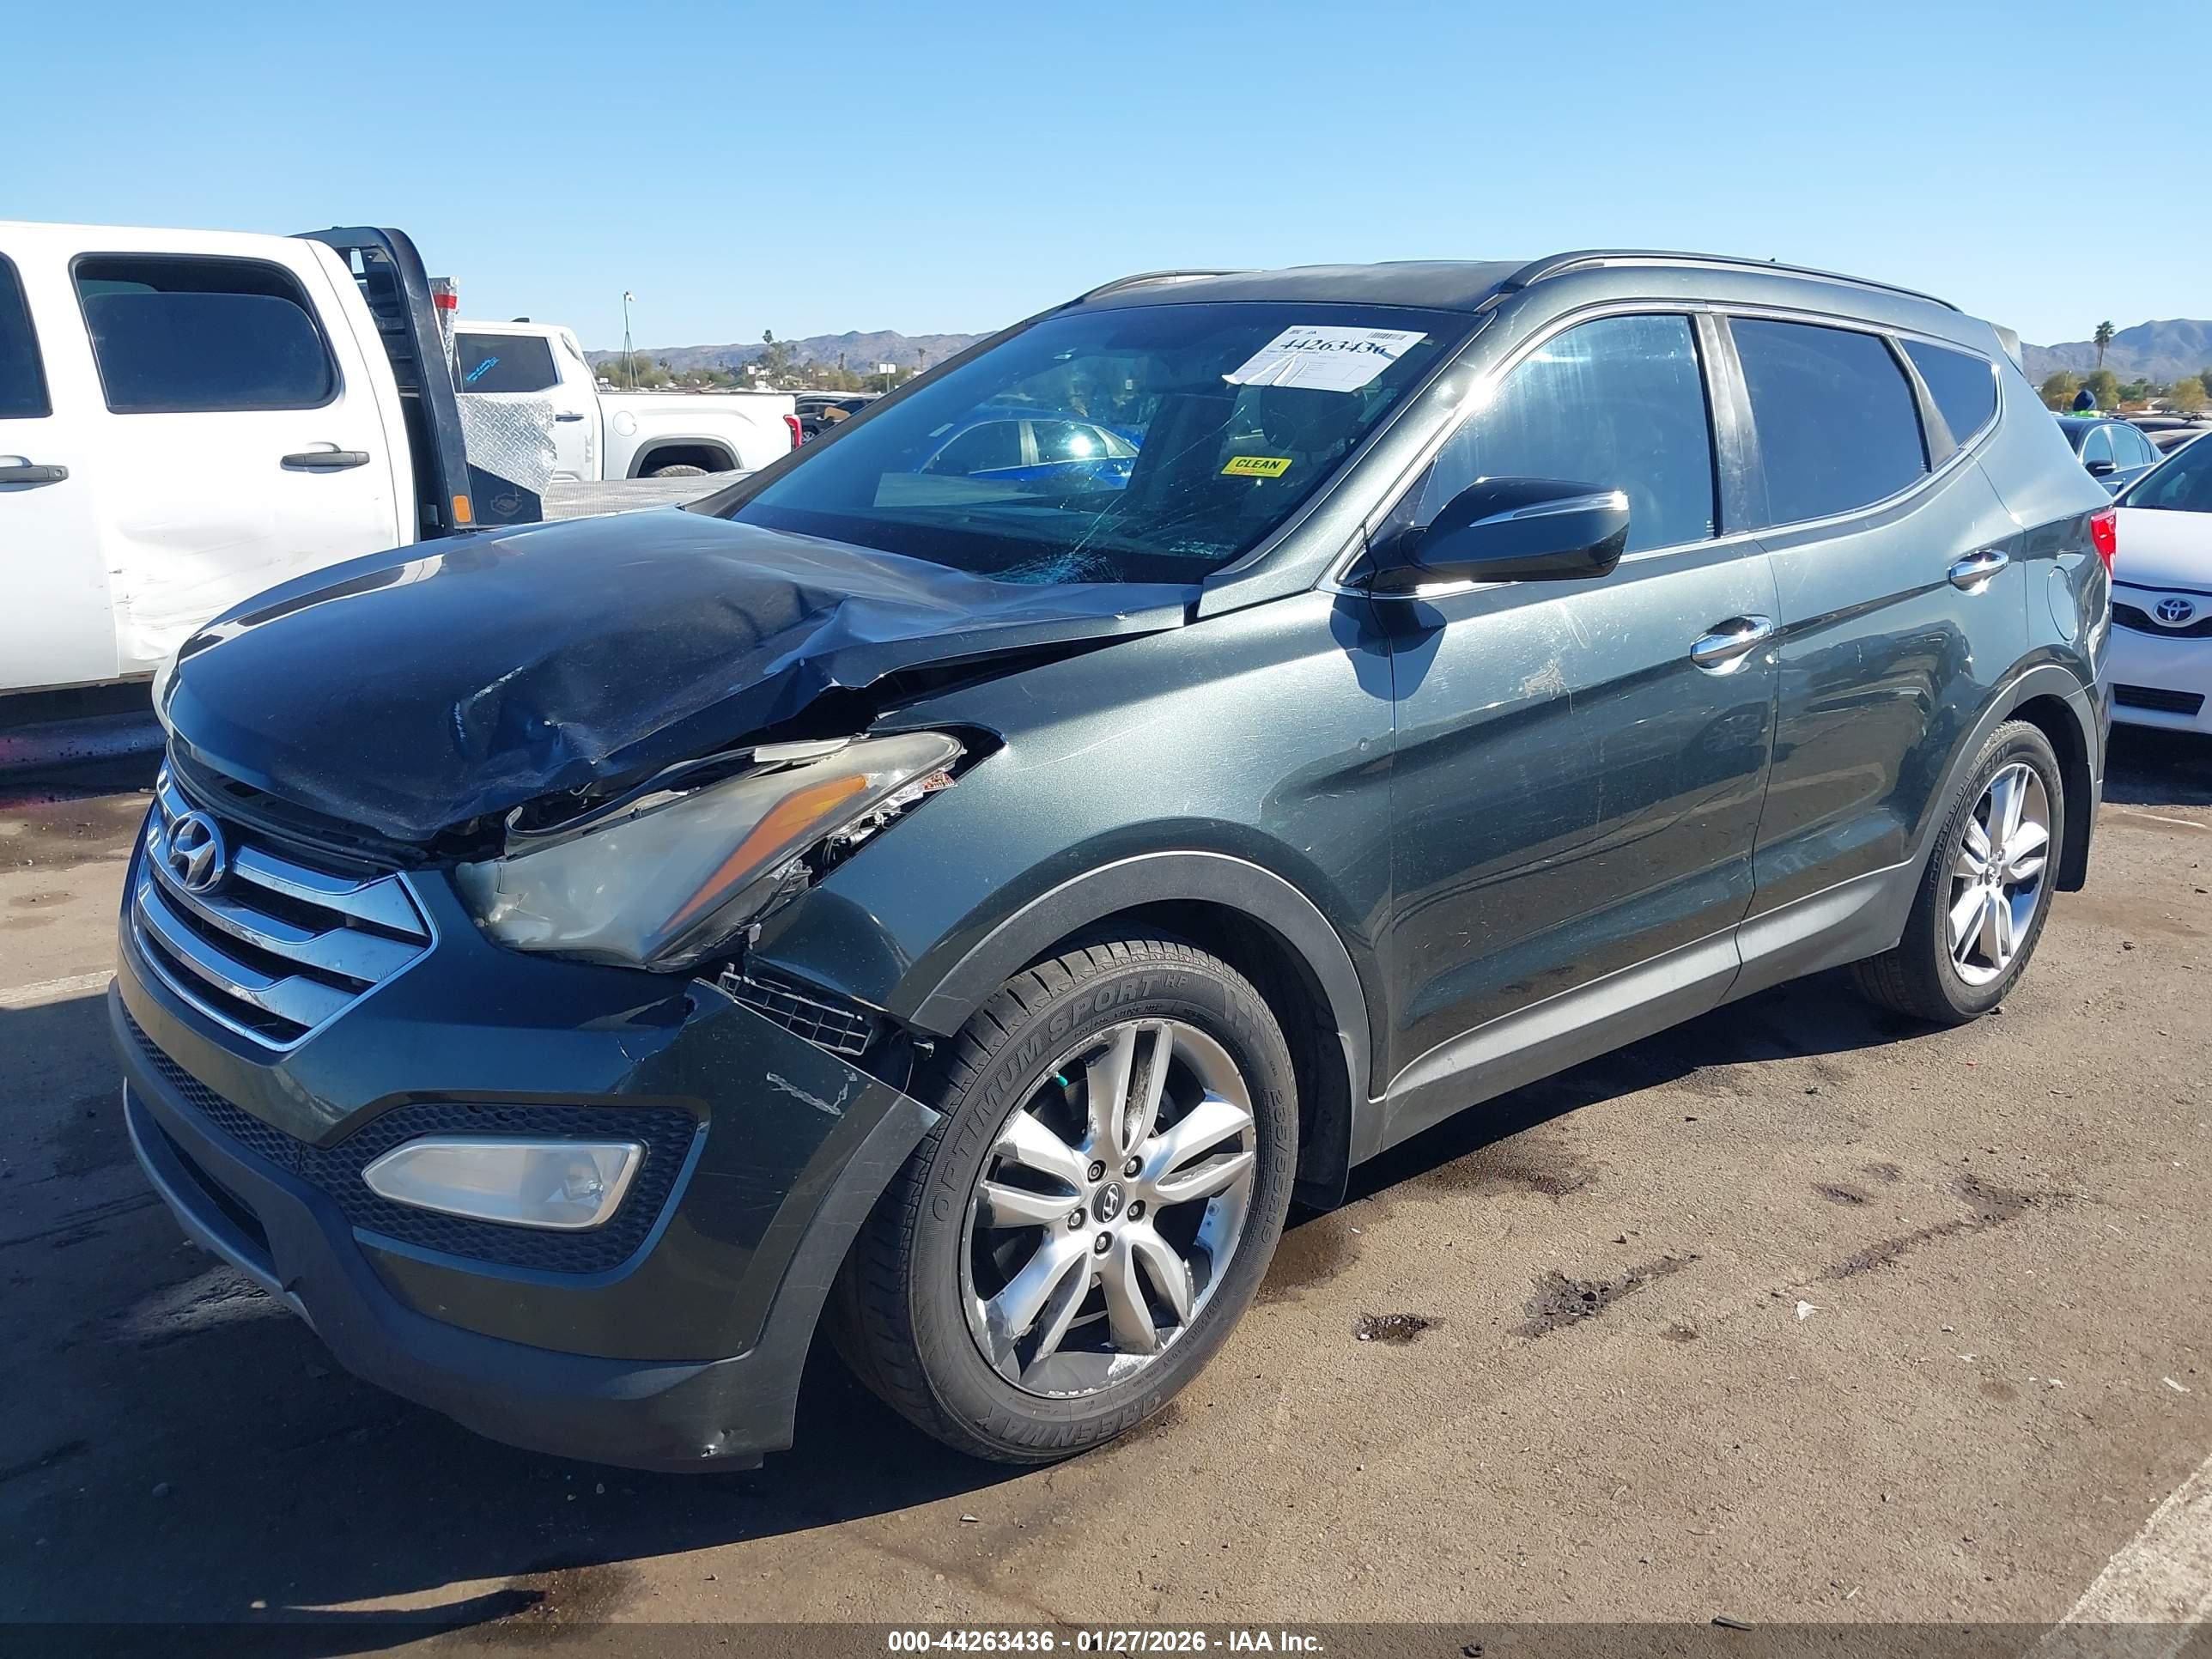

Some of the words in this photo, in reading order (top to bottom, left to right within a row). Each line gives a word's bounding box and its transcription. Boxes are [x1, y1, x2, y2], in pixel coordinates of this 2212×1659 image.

[1235, 459, 1282, 470] CLEAN
[933, 1030, 1042, 1222] OPTIMUM
[1048, 975, 1158, 1042] SPORT
[975, 1392, 1163, 1448] GREENMAX
